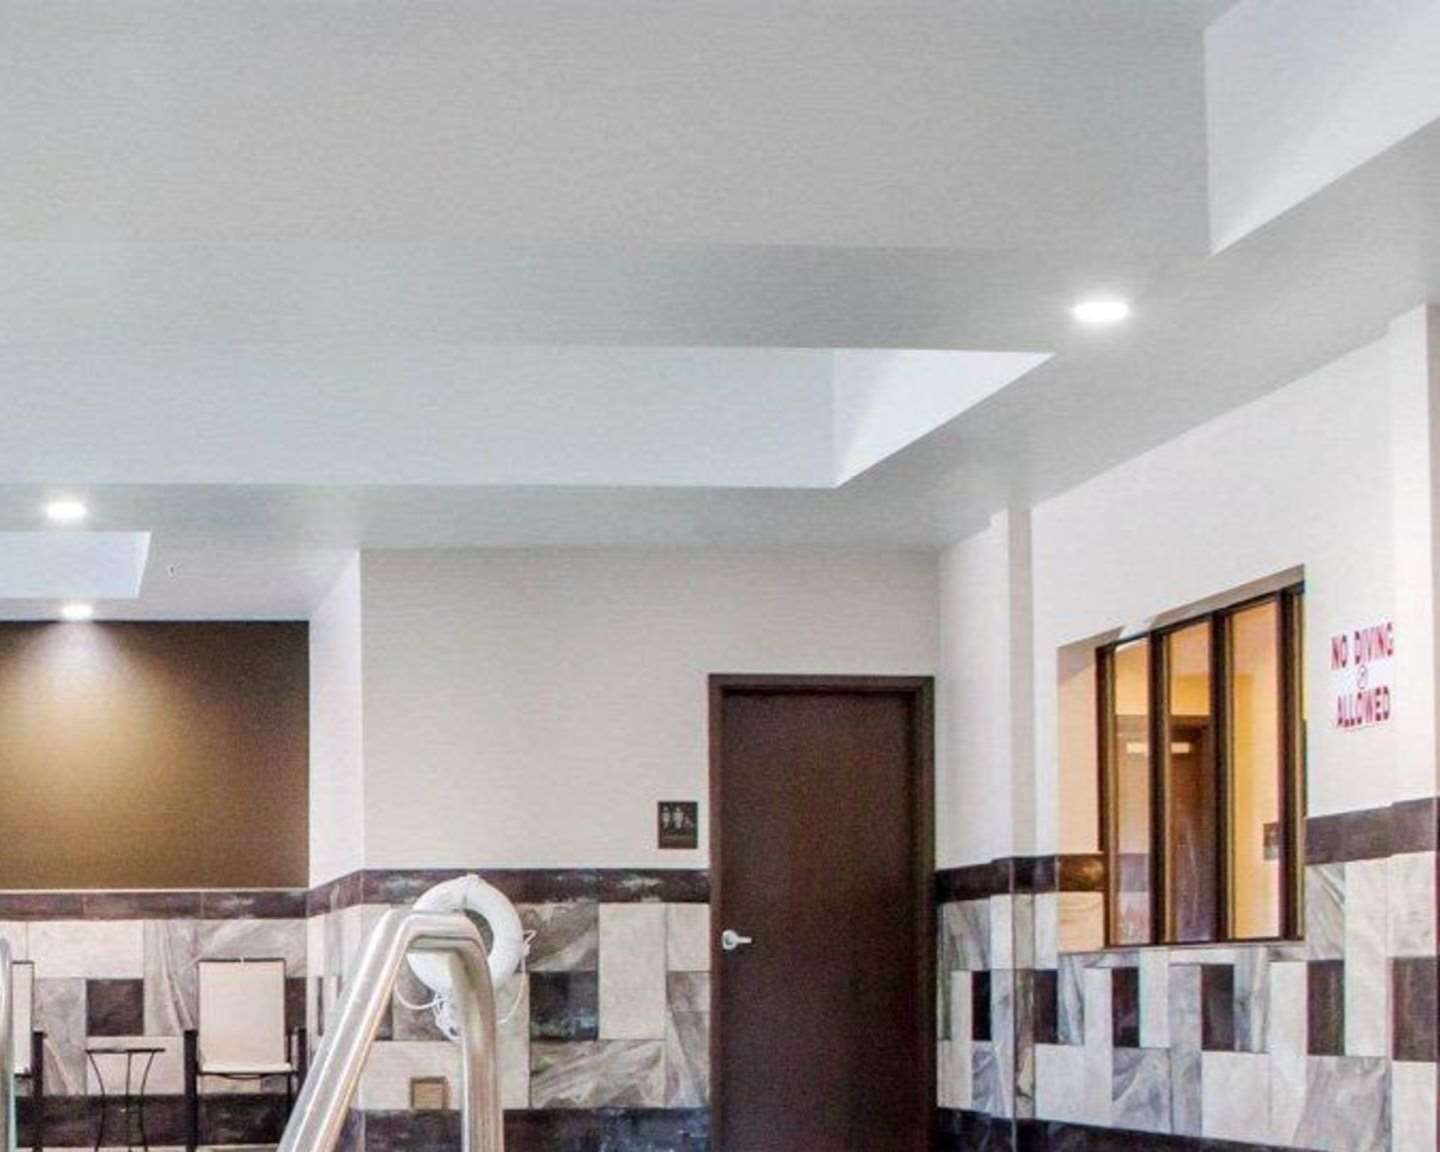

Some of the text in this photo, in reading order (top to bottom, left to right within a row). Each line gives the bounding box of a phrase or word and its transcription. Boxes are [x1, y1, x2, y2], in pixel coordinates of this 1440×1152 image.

[1331, 621, 1392, 670] NO DIVING
[1337, 686, 1390, 727] ALLOWED
